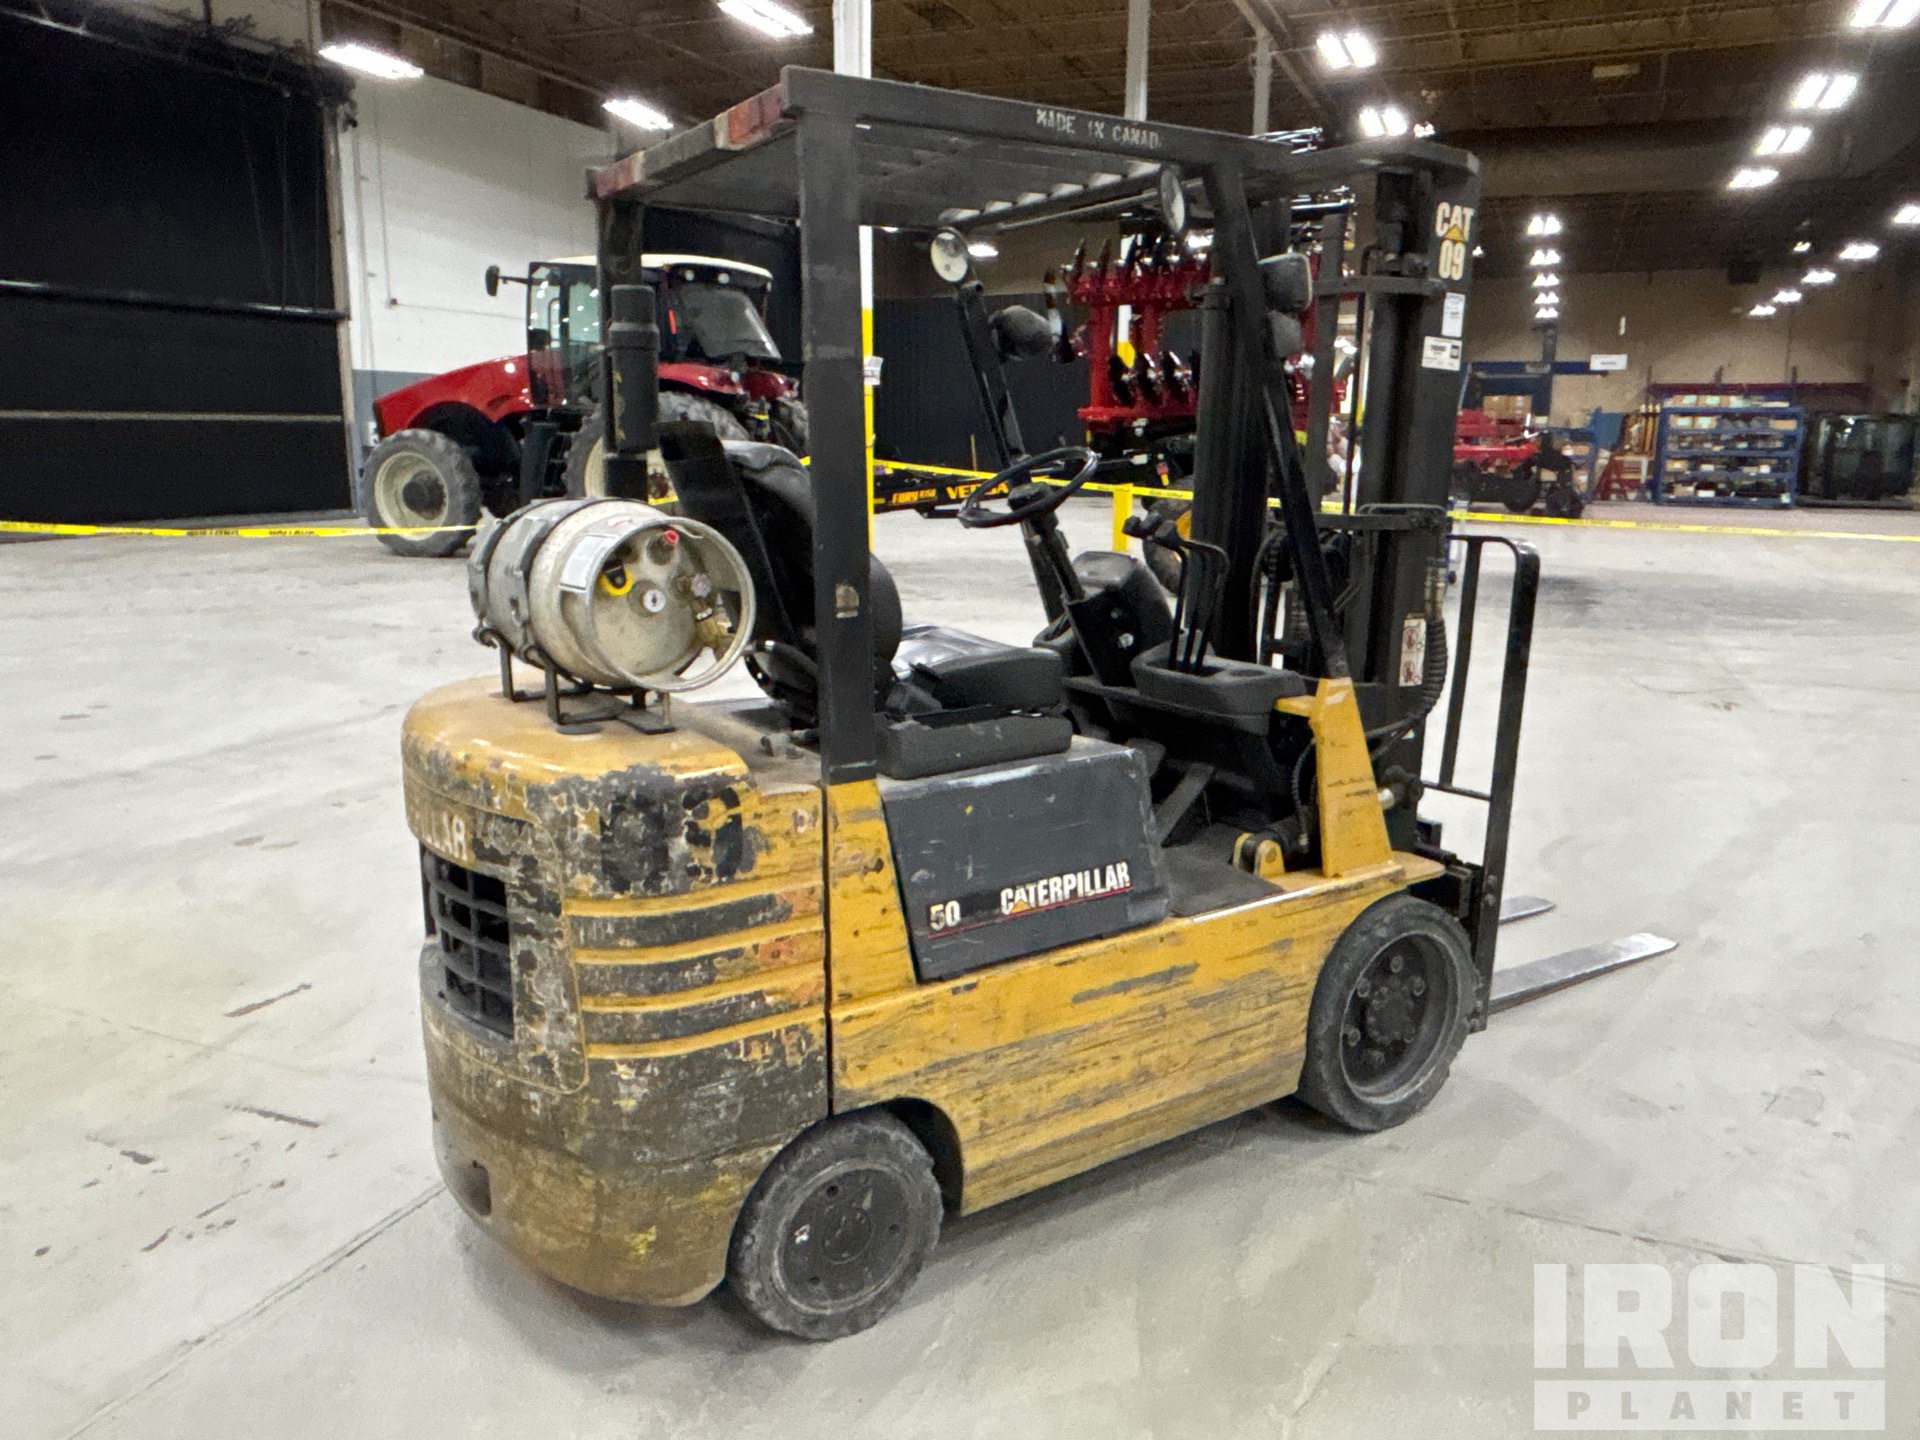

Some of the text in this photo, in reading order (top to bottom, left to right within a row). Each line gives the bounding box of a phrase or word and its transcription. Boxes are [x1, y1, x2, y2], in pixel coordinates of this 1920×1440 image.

[1436, 201, 1475, 242] CAT
[1438, 239, 1466, 281] 09
[929, 861, 1131, 931] 50 CATERPILLAR
